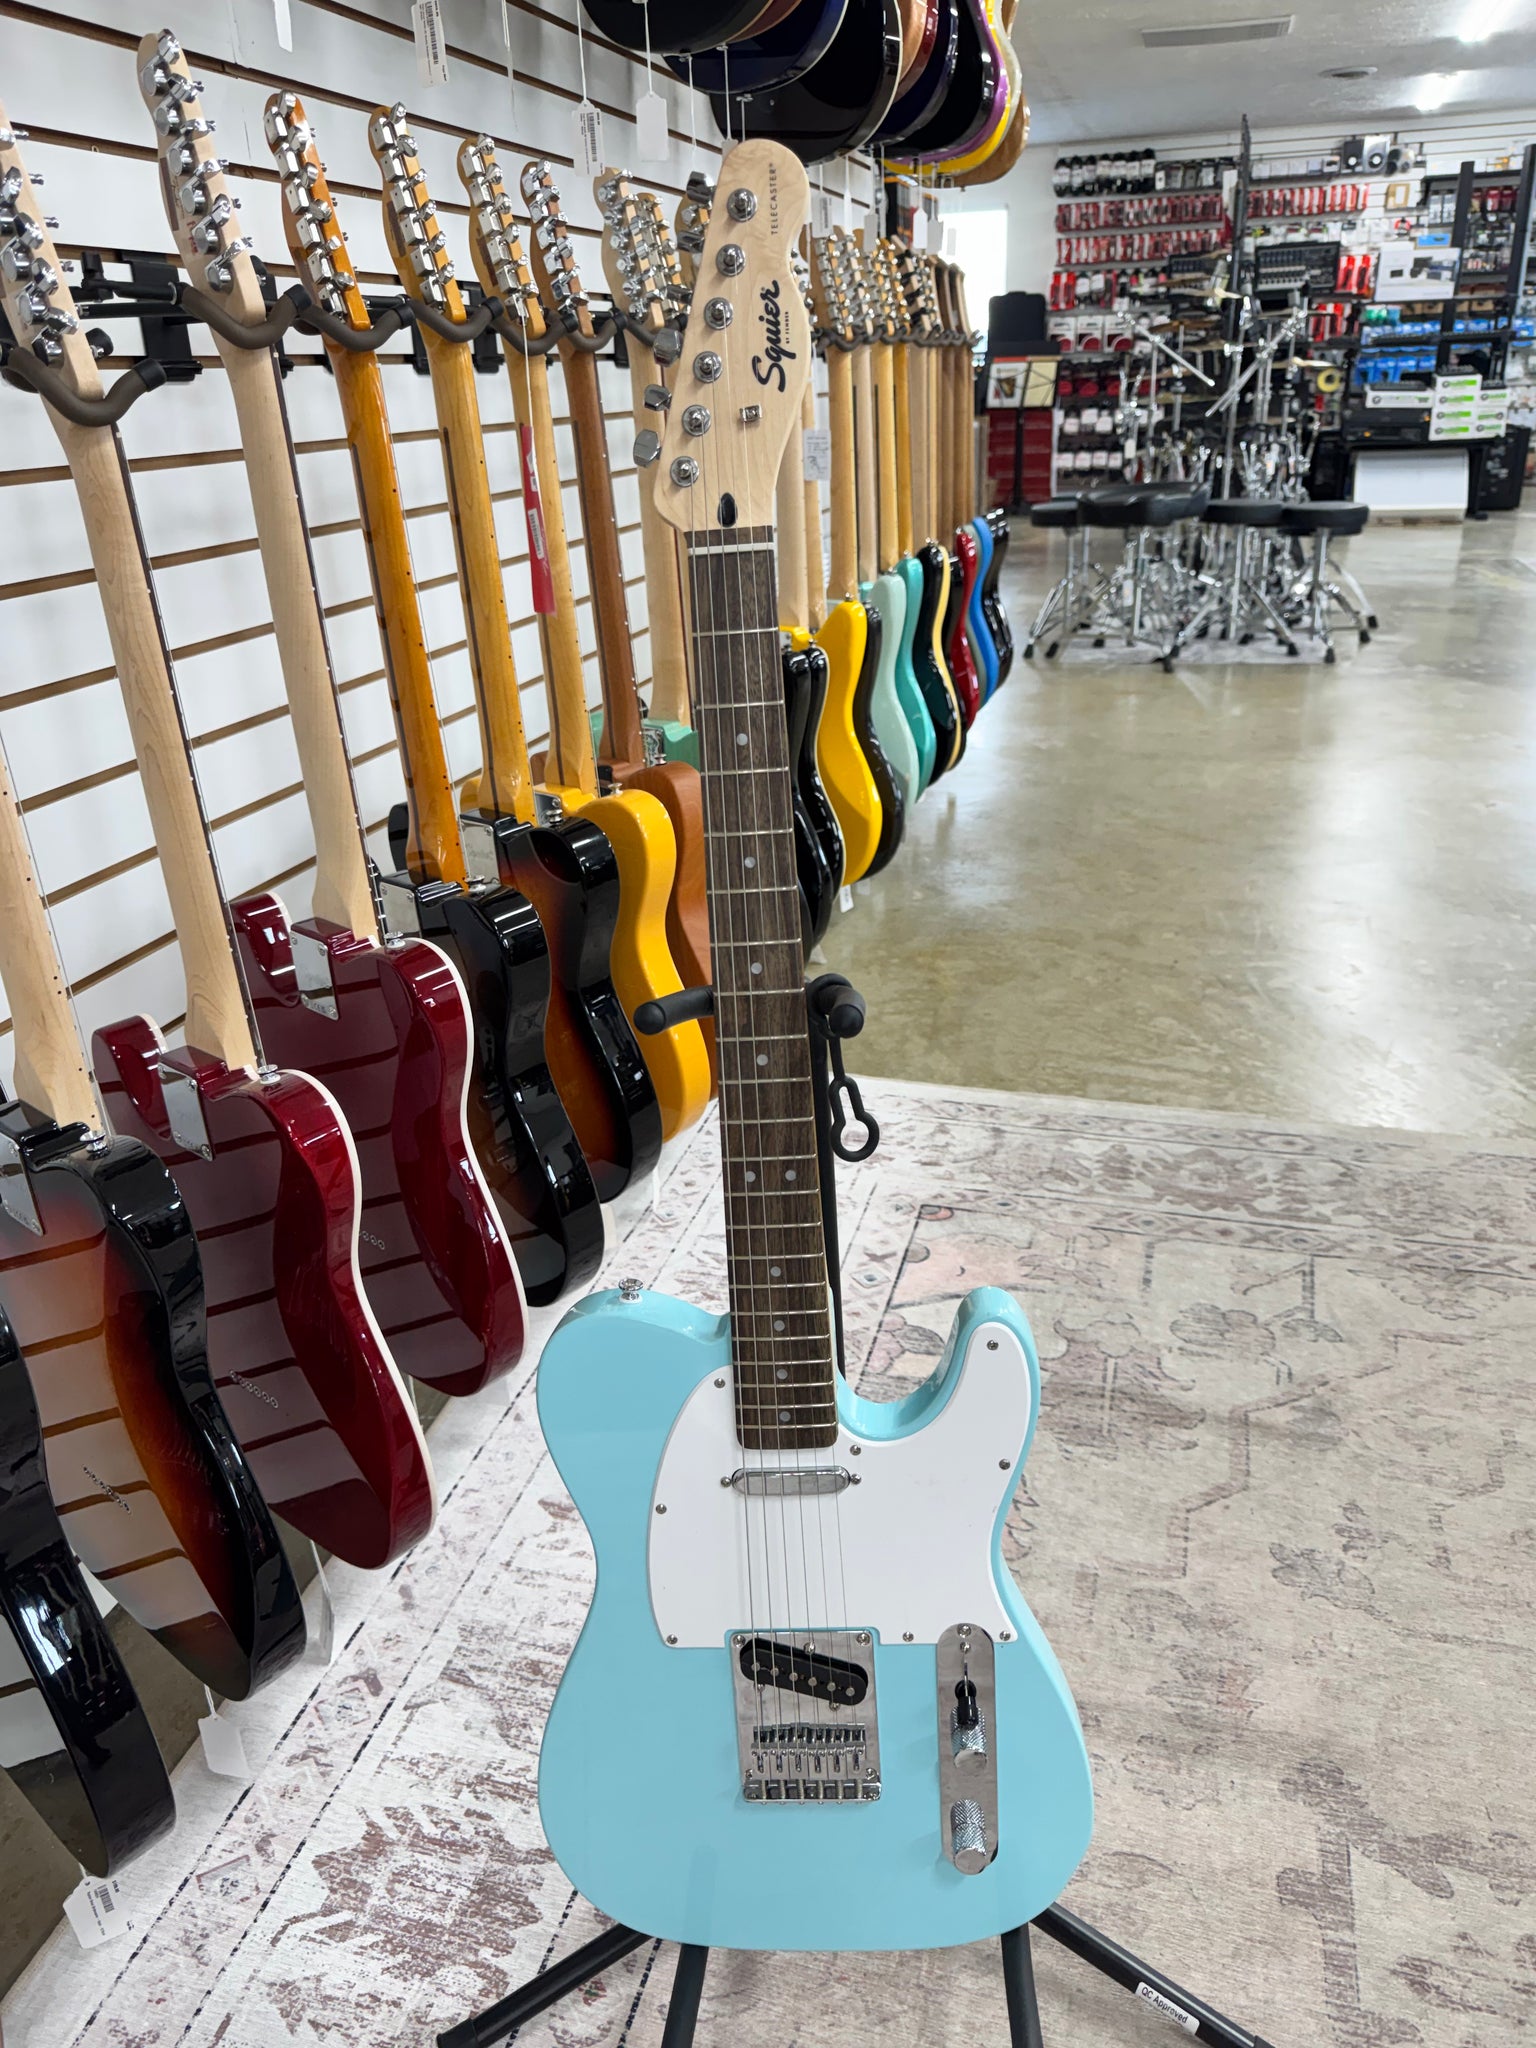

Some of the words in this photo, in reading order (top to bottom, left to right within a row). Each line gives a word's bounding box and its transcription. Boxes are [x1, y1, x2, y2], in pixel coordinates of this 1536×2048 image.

[769, 168, 779, 235] TELECASTER
[752, 280, 797, 392] Squier
[1141, 1986, 1154, 1999] QC
[1153, 1995, 1189, 2024] Approved
